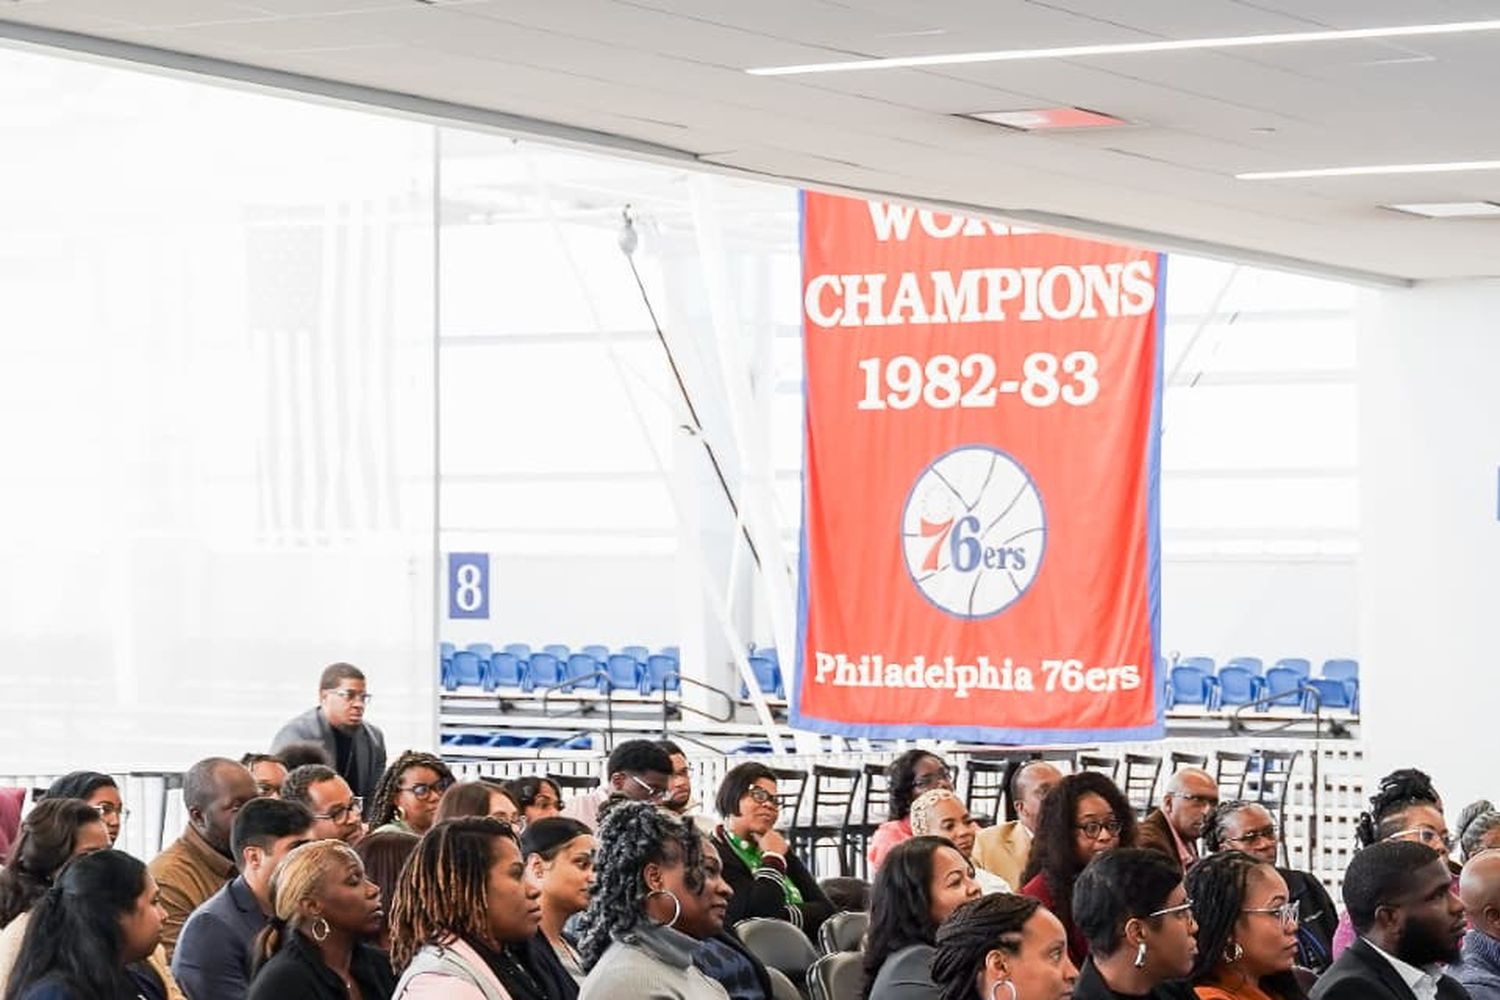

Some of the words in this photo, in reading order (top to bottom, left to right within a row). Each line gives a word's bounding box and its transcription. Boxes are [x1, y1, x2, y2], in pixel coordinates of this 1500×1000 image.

[805, 260, 1155, 328] CHAMPIONS
[857, 350, 1100, 410] 1982-83
[920, 515, 1027, 573] 76ers
[456, 563, 482, 612] 8
[815, 652, 1034, 698] Philadelphia
[1041, 659, 1142, 693] 76ers
